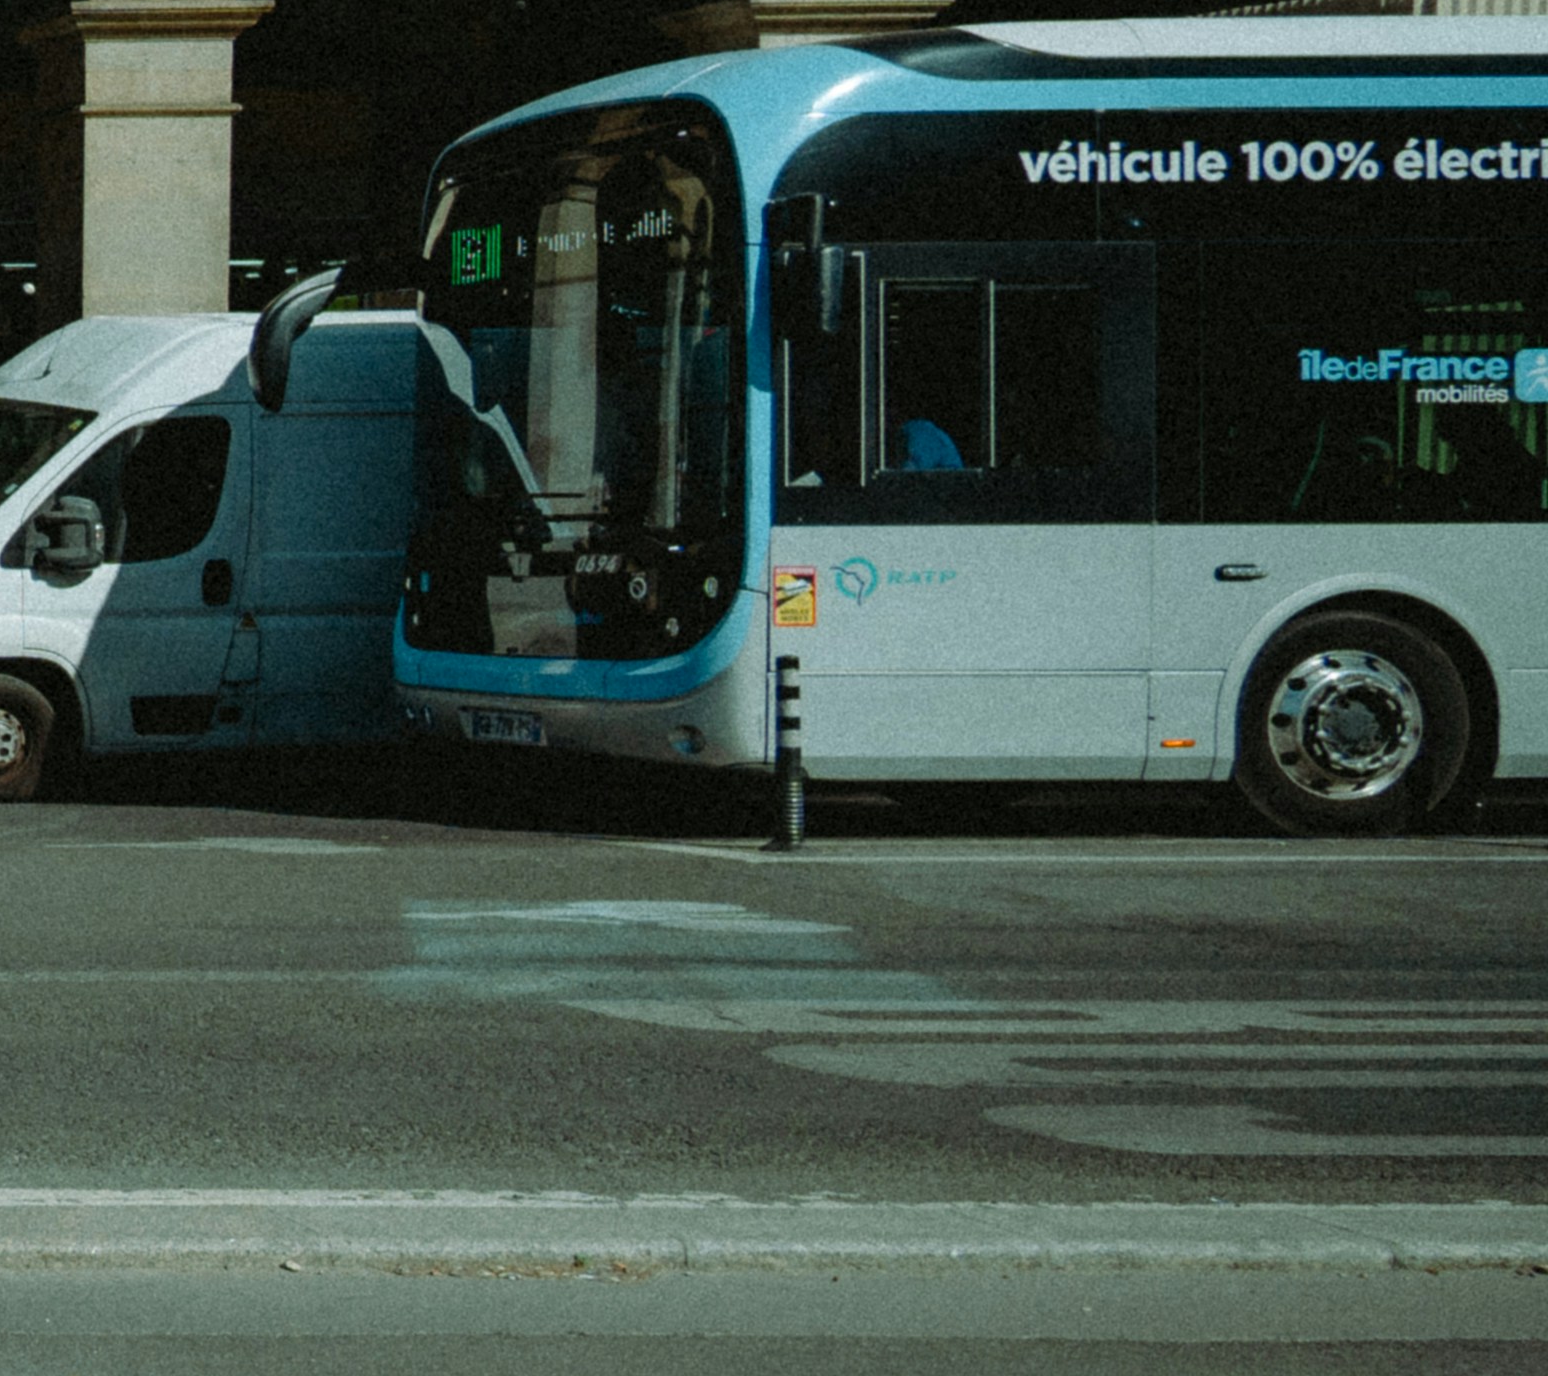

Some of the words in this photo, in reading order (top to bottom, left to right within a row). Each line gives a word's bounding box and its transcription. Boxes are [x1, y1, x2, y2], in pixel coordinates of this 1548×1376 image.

[1019, 140, 1229, 183] véhicule
[1241, 140, 1381, 182] 100%
[1393, 137, 1548, 181] électri
[1416, 383, 1509, 403] mobilités
[887, 569, 958, 584] RATP
